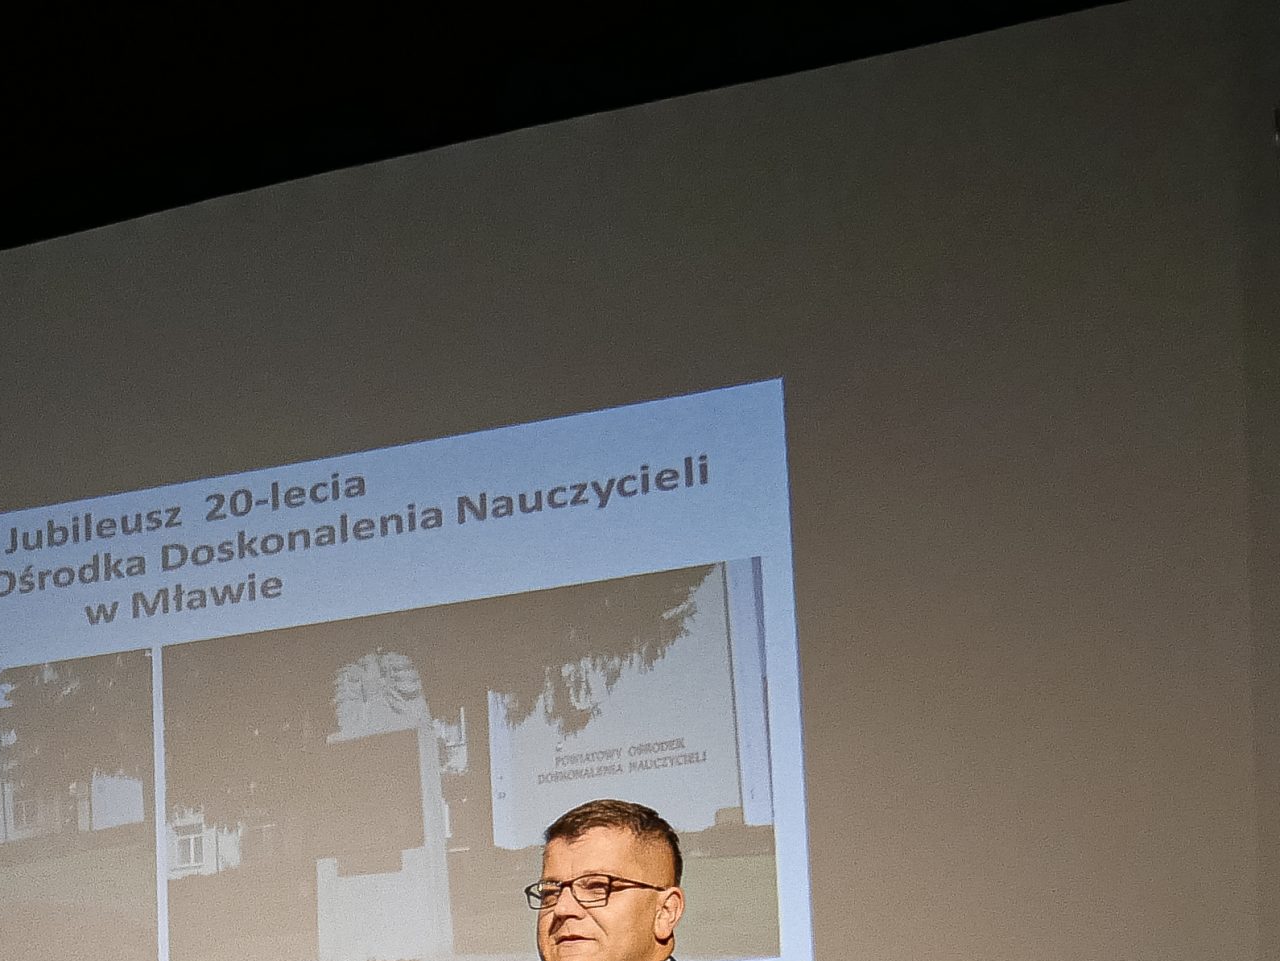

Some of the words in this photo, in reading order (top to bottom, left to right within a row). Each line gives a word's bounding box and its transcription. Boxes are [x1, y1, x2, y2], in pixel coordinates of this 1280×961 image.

[4, 503, 182, 555] Jubileusz
[204, 472, 367, 522] 20-lecia
[161, 503, 444, 573] Doskonalenia
[457, 453, 710, 524] Nauczycieli
[85, 600, 119, 626] w
[132, 572, 284, 620] Mławie
